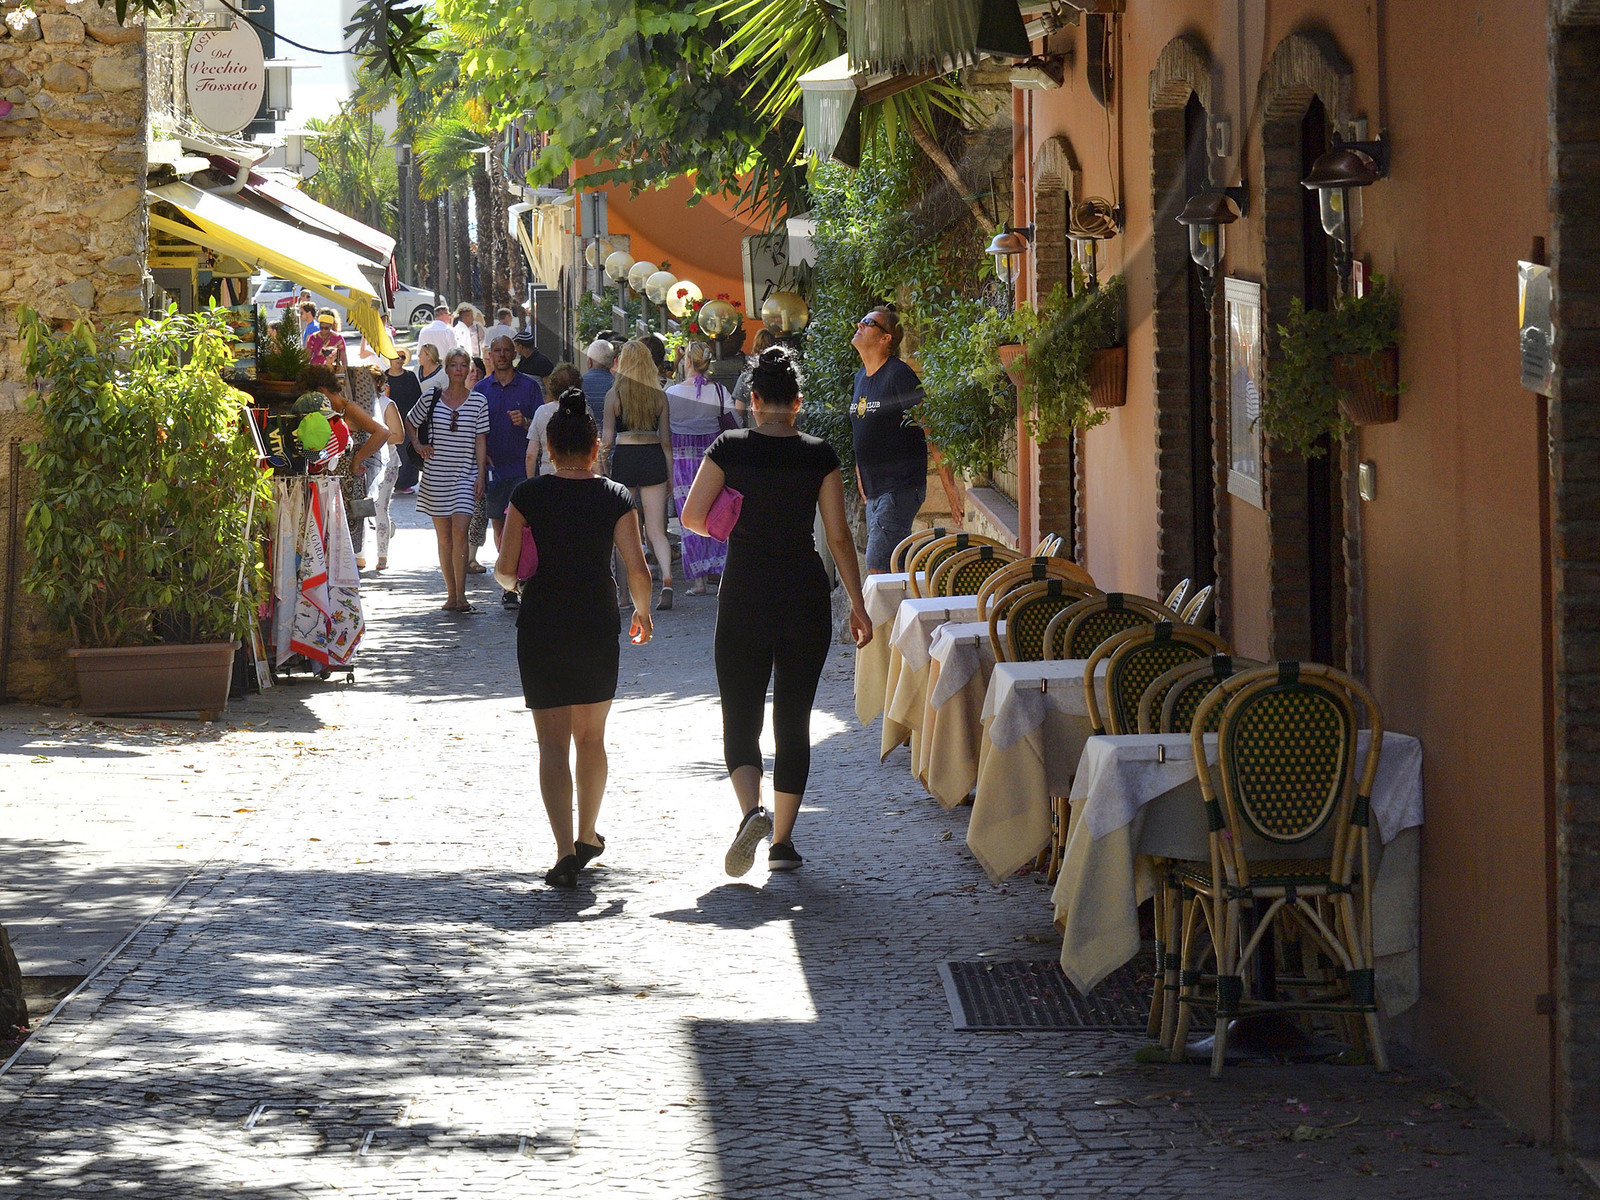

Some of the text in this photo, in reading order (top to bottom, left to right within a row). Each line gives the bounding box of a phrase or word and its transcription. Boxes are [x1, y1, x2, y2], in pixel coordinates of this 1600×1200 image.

[211, 49, 233, 59] Del
[190, 61, 247, 75] Vecchio
[195, 78, 257, 92] Fossato
[866, 401, 881, 409] CLUB
[311, 534, 325, 567] GARDA
